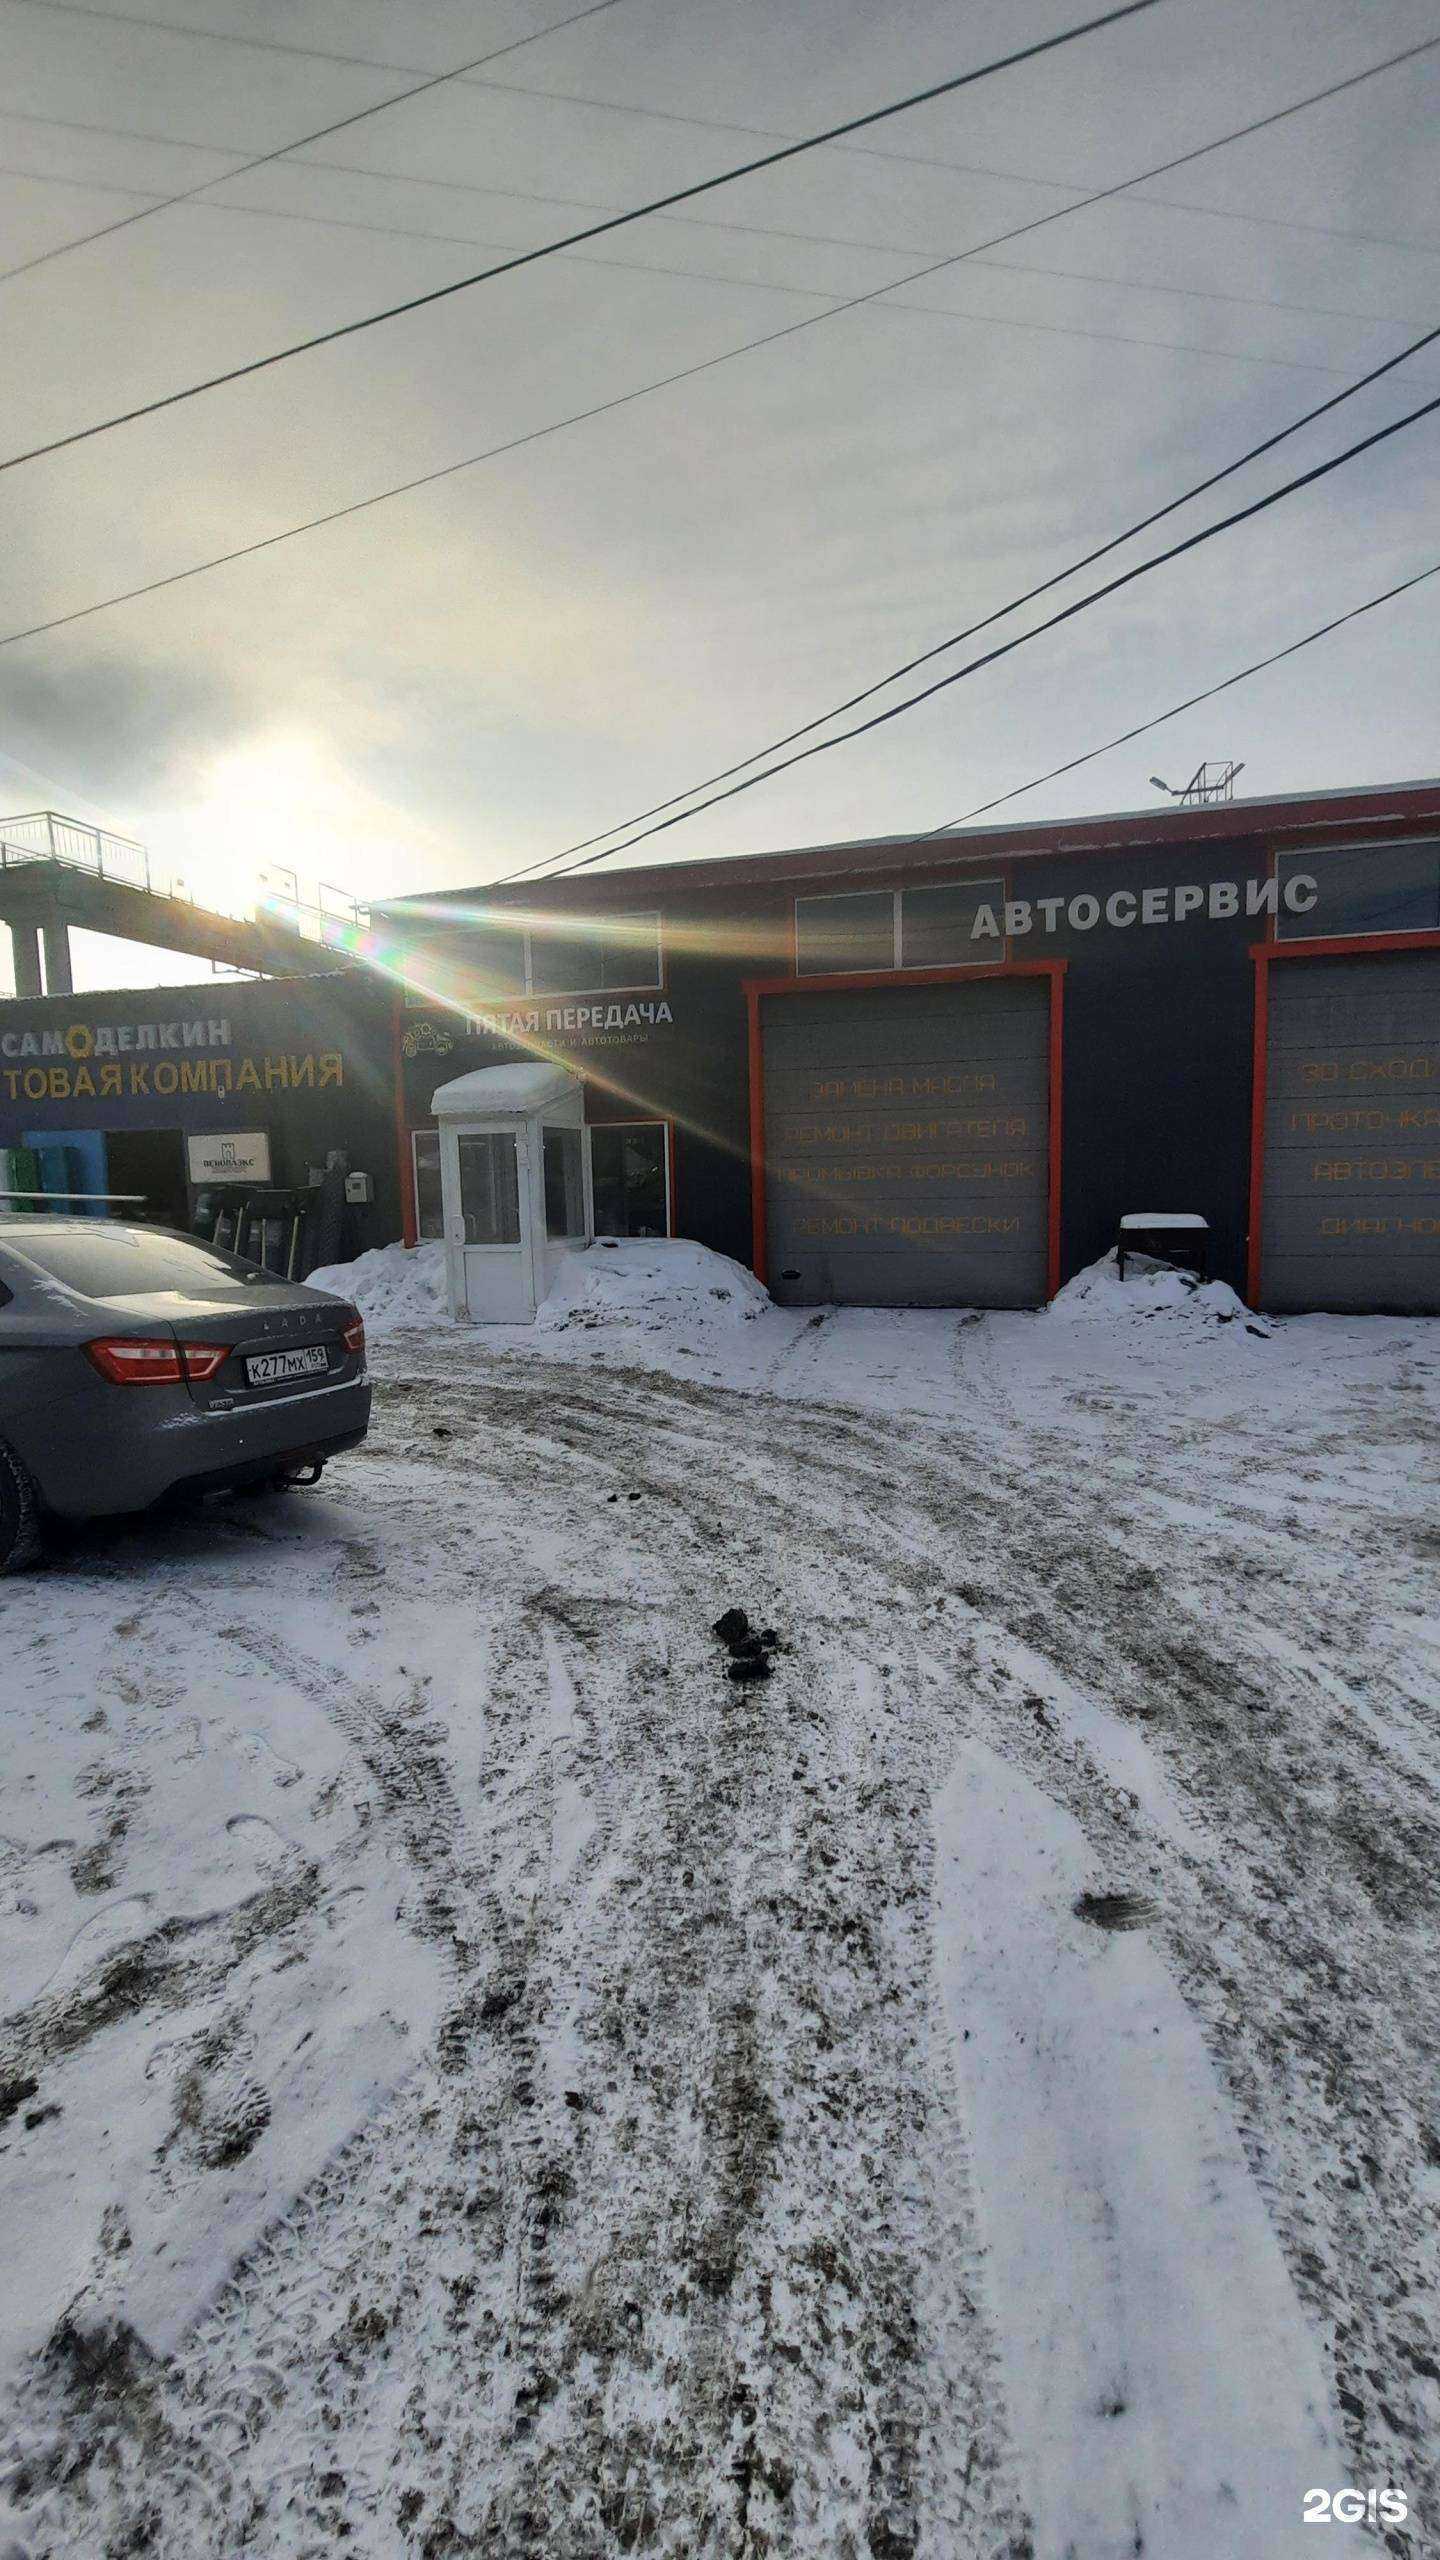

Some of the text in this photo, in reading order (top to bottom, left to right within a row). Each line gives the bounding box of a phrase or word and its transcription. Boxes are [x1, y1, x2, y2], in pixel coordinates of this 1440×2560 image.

[970, 874, 1319, 940] АВТОСЕРВИС
[546, 1001, 674, 1031] ПЕРЕДАЧА
[1, 1019, 232, 1059] САМОДЕЛКИН
[3, 1051, 343, 1100] ТОВАЯ КОМПАНИЯ
[910, 1161, 1035, 1179] ФОРСУНОК
[1321, 1217, 1440, 1235] ДИАГНО
[263, 1313, 322, 1330] LADA
[251, 1347, 325, 1380] К277МХ 159
